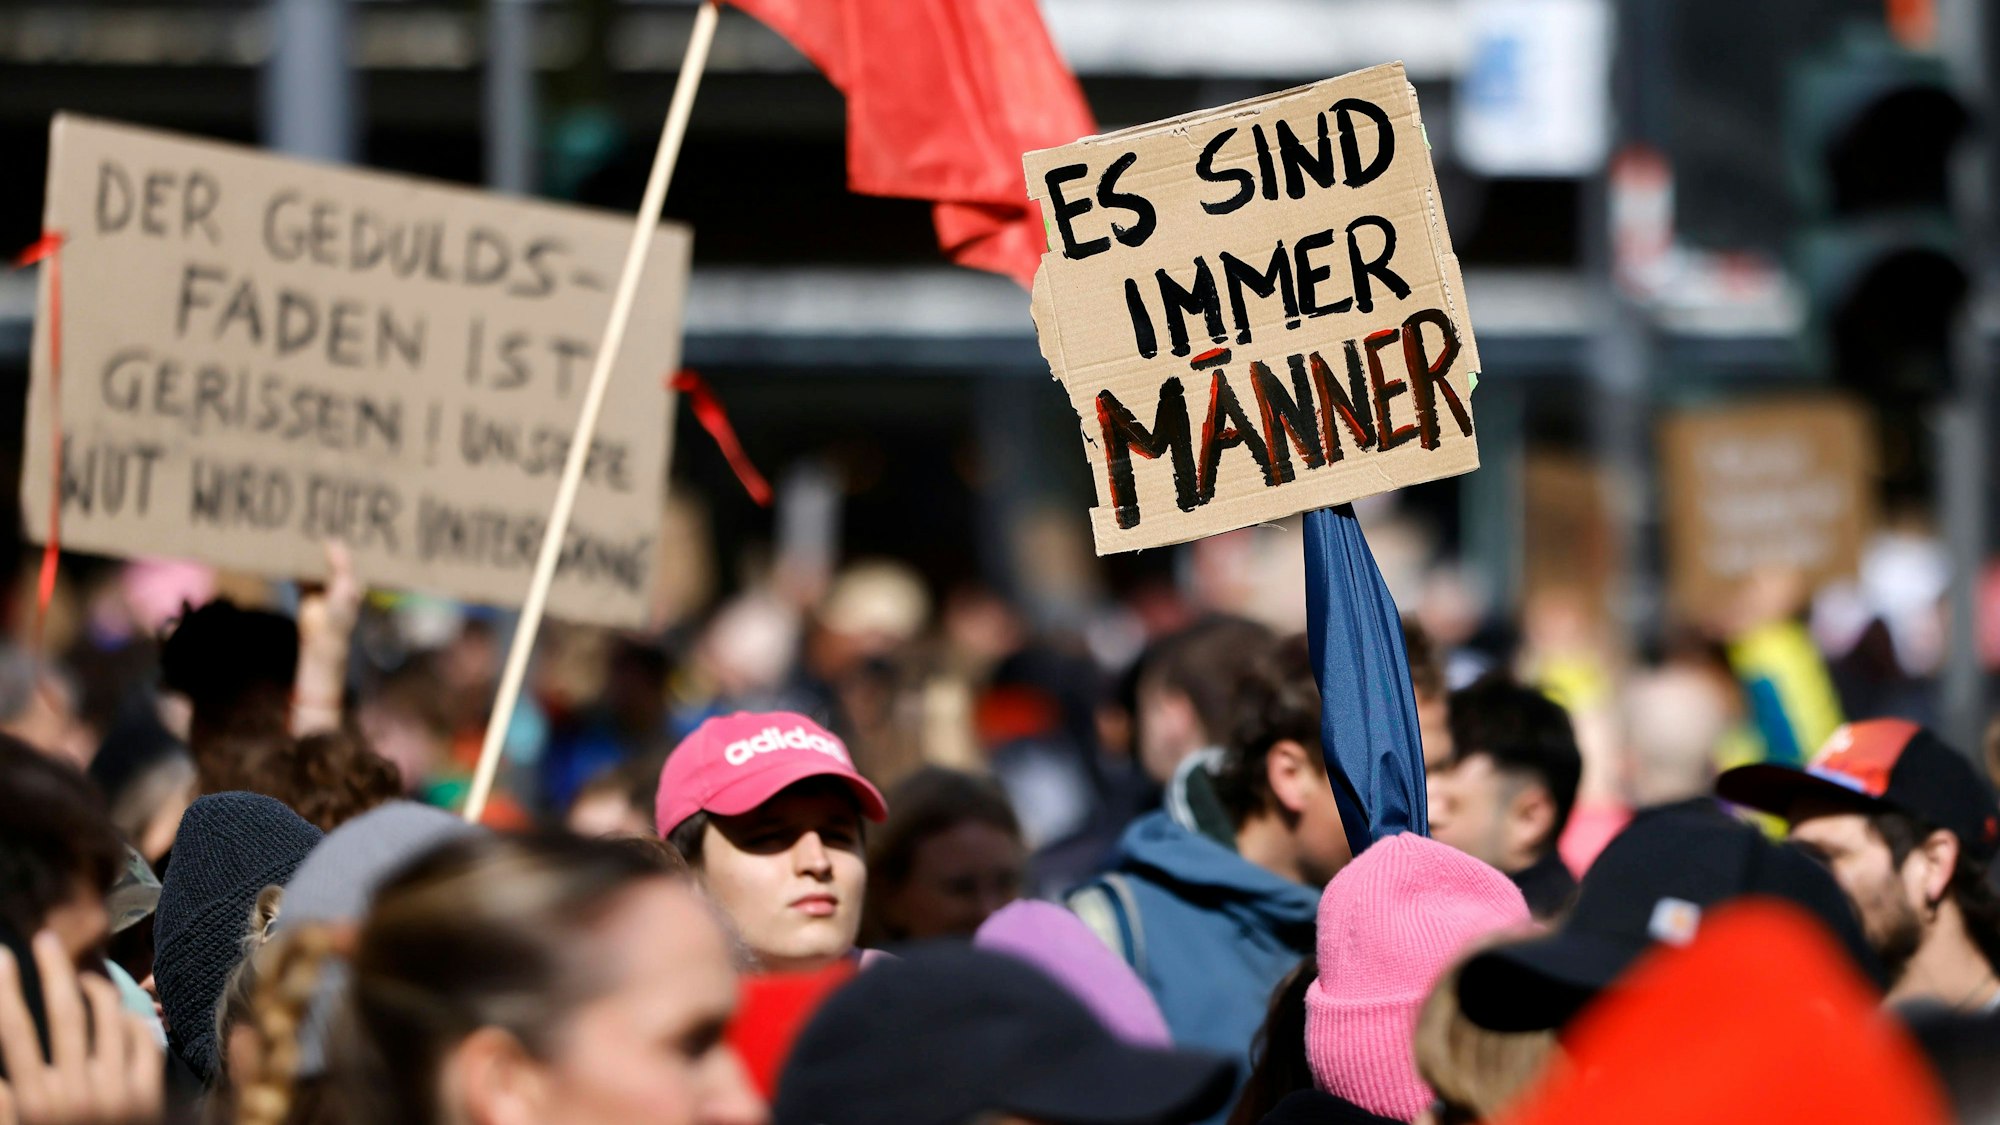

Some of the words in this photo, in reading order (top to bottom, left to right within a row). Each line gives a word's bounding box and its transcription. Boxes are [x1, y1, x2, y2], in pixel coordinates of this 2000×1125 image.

[95, 161, 222, 246] DER
[262, 189, 606, 297] GEDULDS-
[1044, 151, 1157, 260] ES
[1195, 98, 1395, 215] SIND
[175, 263, 426, 371] FADEN
[463, 317, 593, 397] IST
[1124, 215, 1412, 359] IMMER
[103, 347, 402, 449] GERISSEN
[58, 431, 164, 519] WUT
[190, 456, 295, 530] WIRD
